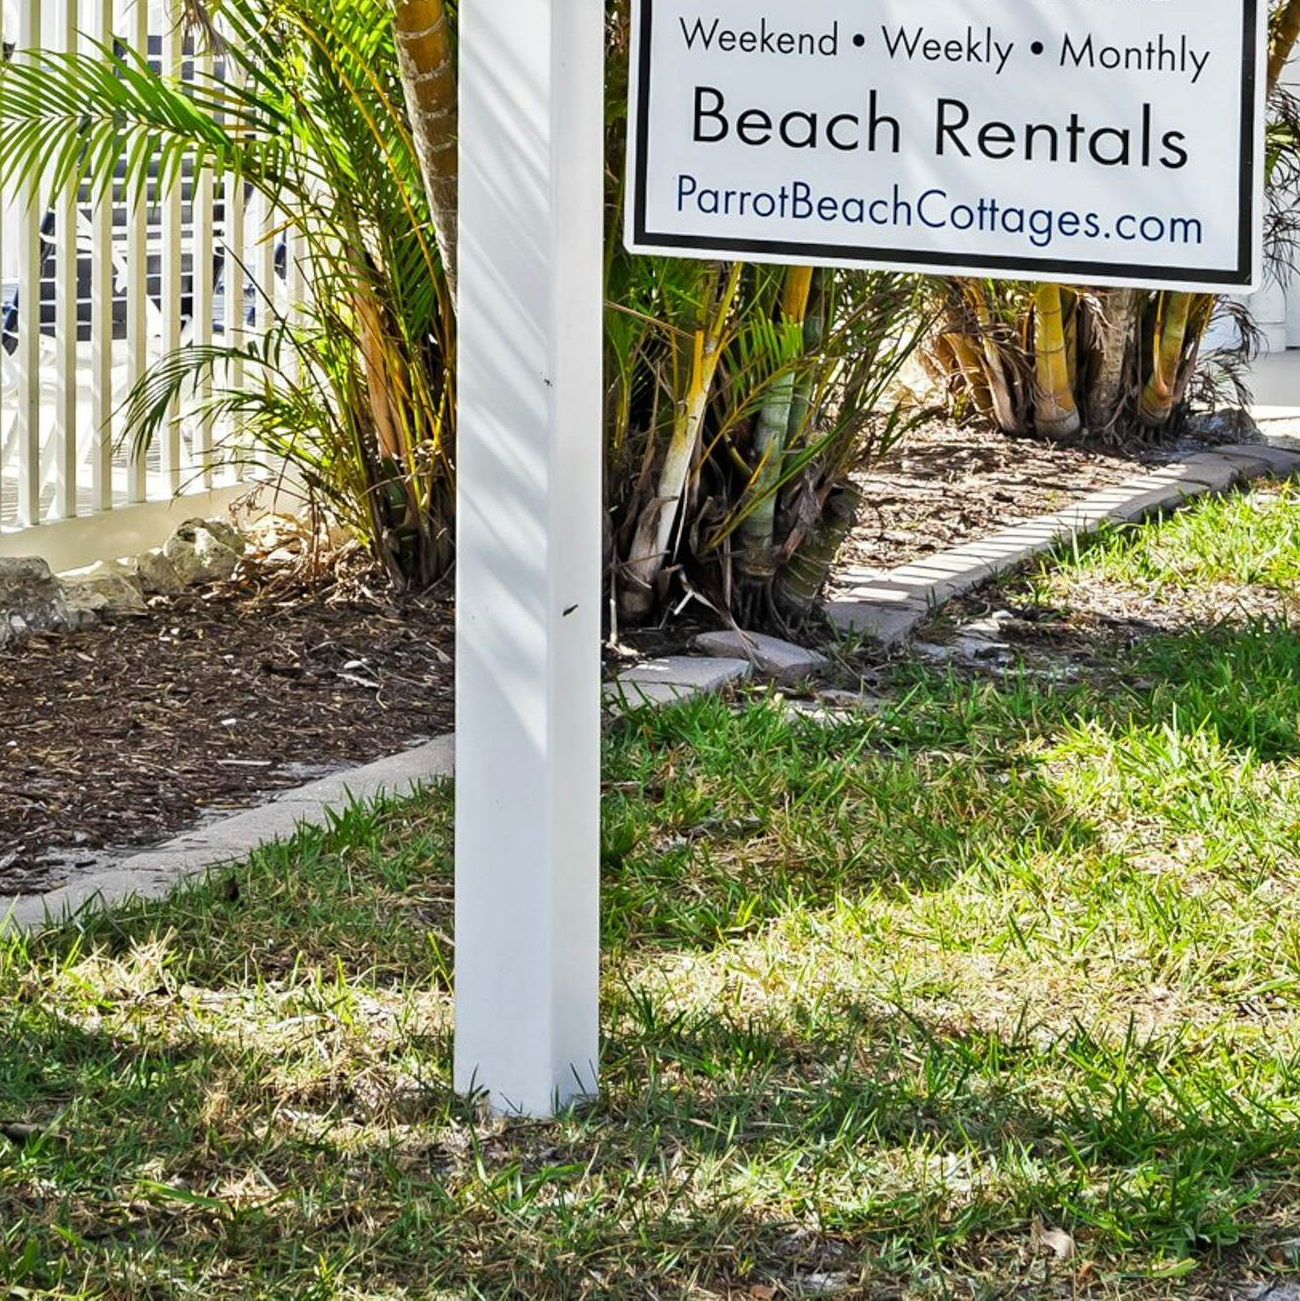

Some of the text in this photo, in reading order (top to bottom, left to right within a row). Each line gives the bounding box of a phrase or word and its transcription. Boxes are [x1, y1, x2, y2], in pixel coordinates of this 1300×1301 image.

[679, 16, 1211, 84] Weekend Weekly Monthly
[693, 86, 1188, 170] Beach Rentals
[676, 175, 1202, 247] ParrotBeachCottages.com
